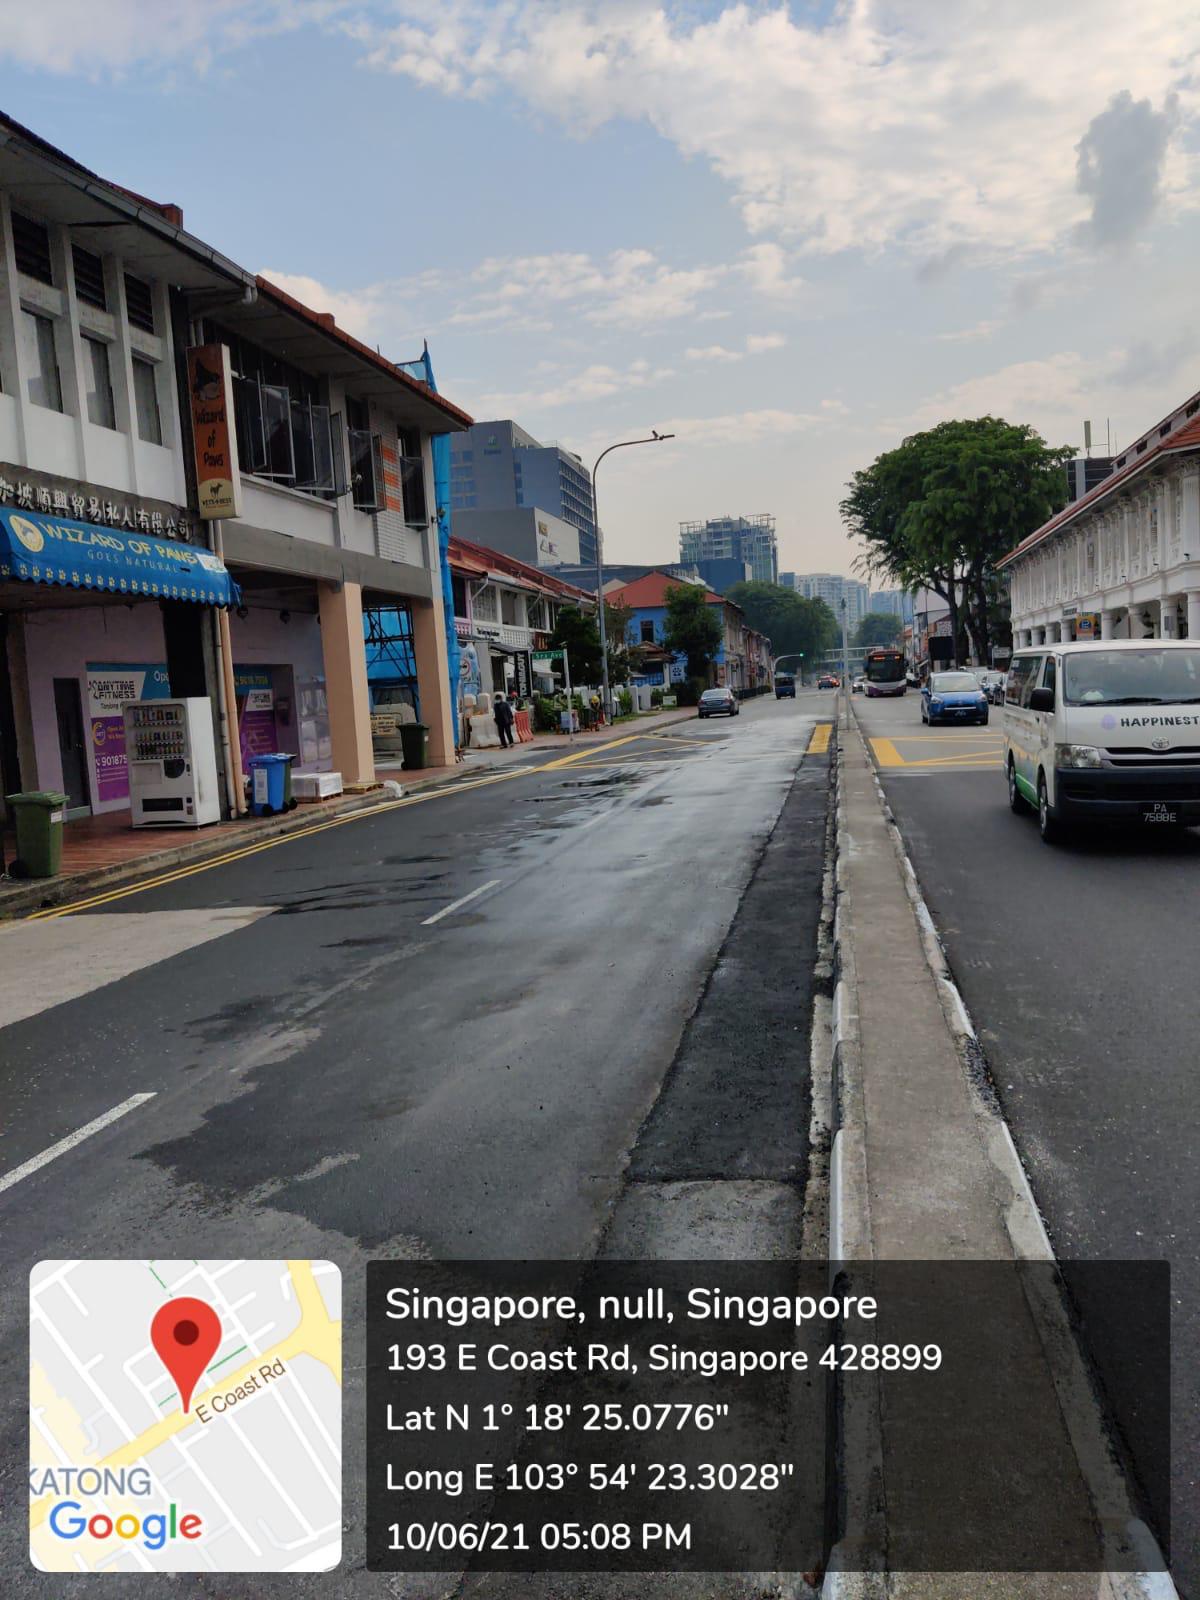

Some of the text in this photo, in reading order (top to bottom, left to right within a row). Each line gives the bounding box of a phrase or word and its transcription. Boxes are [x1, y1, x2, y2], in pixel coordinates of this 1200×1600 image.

[207, 430, 217, 448] of
[38, 521, 125, 552] WIZARD
[128, 540, 152, 556] OF
[154, 543, 198, 565] PAWS
[87, 549, 178, 573] GOES NATURAL
[97, 680, 135, 691] ANYTIME
[98, 691, 136, 700] FITNESS
[1120, 716, 1200, 728] HAPPINEST
[1154, 803, 1167, 812] PA
[1142, 812, 1177, 823] 7588E
